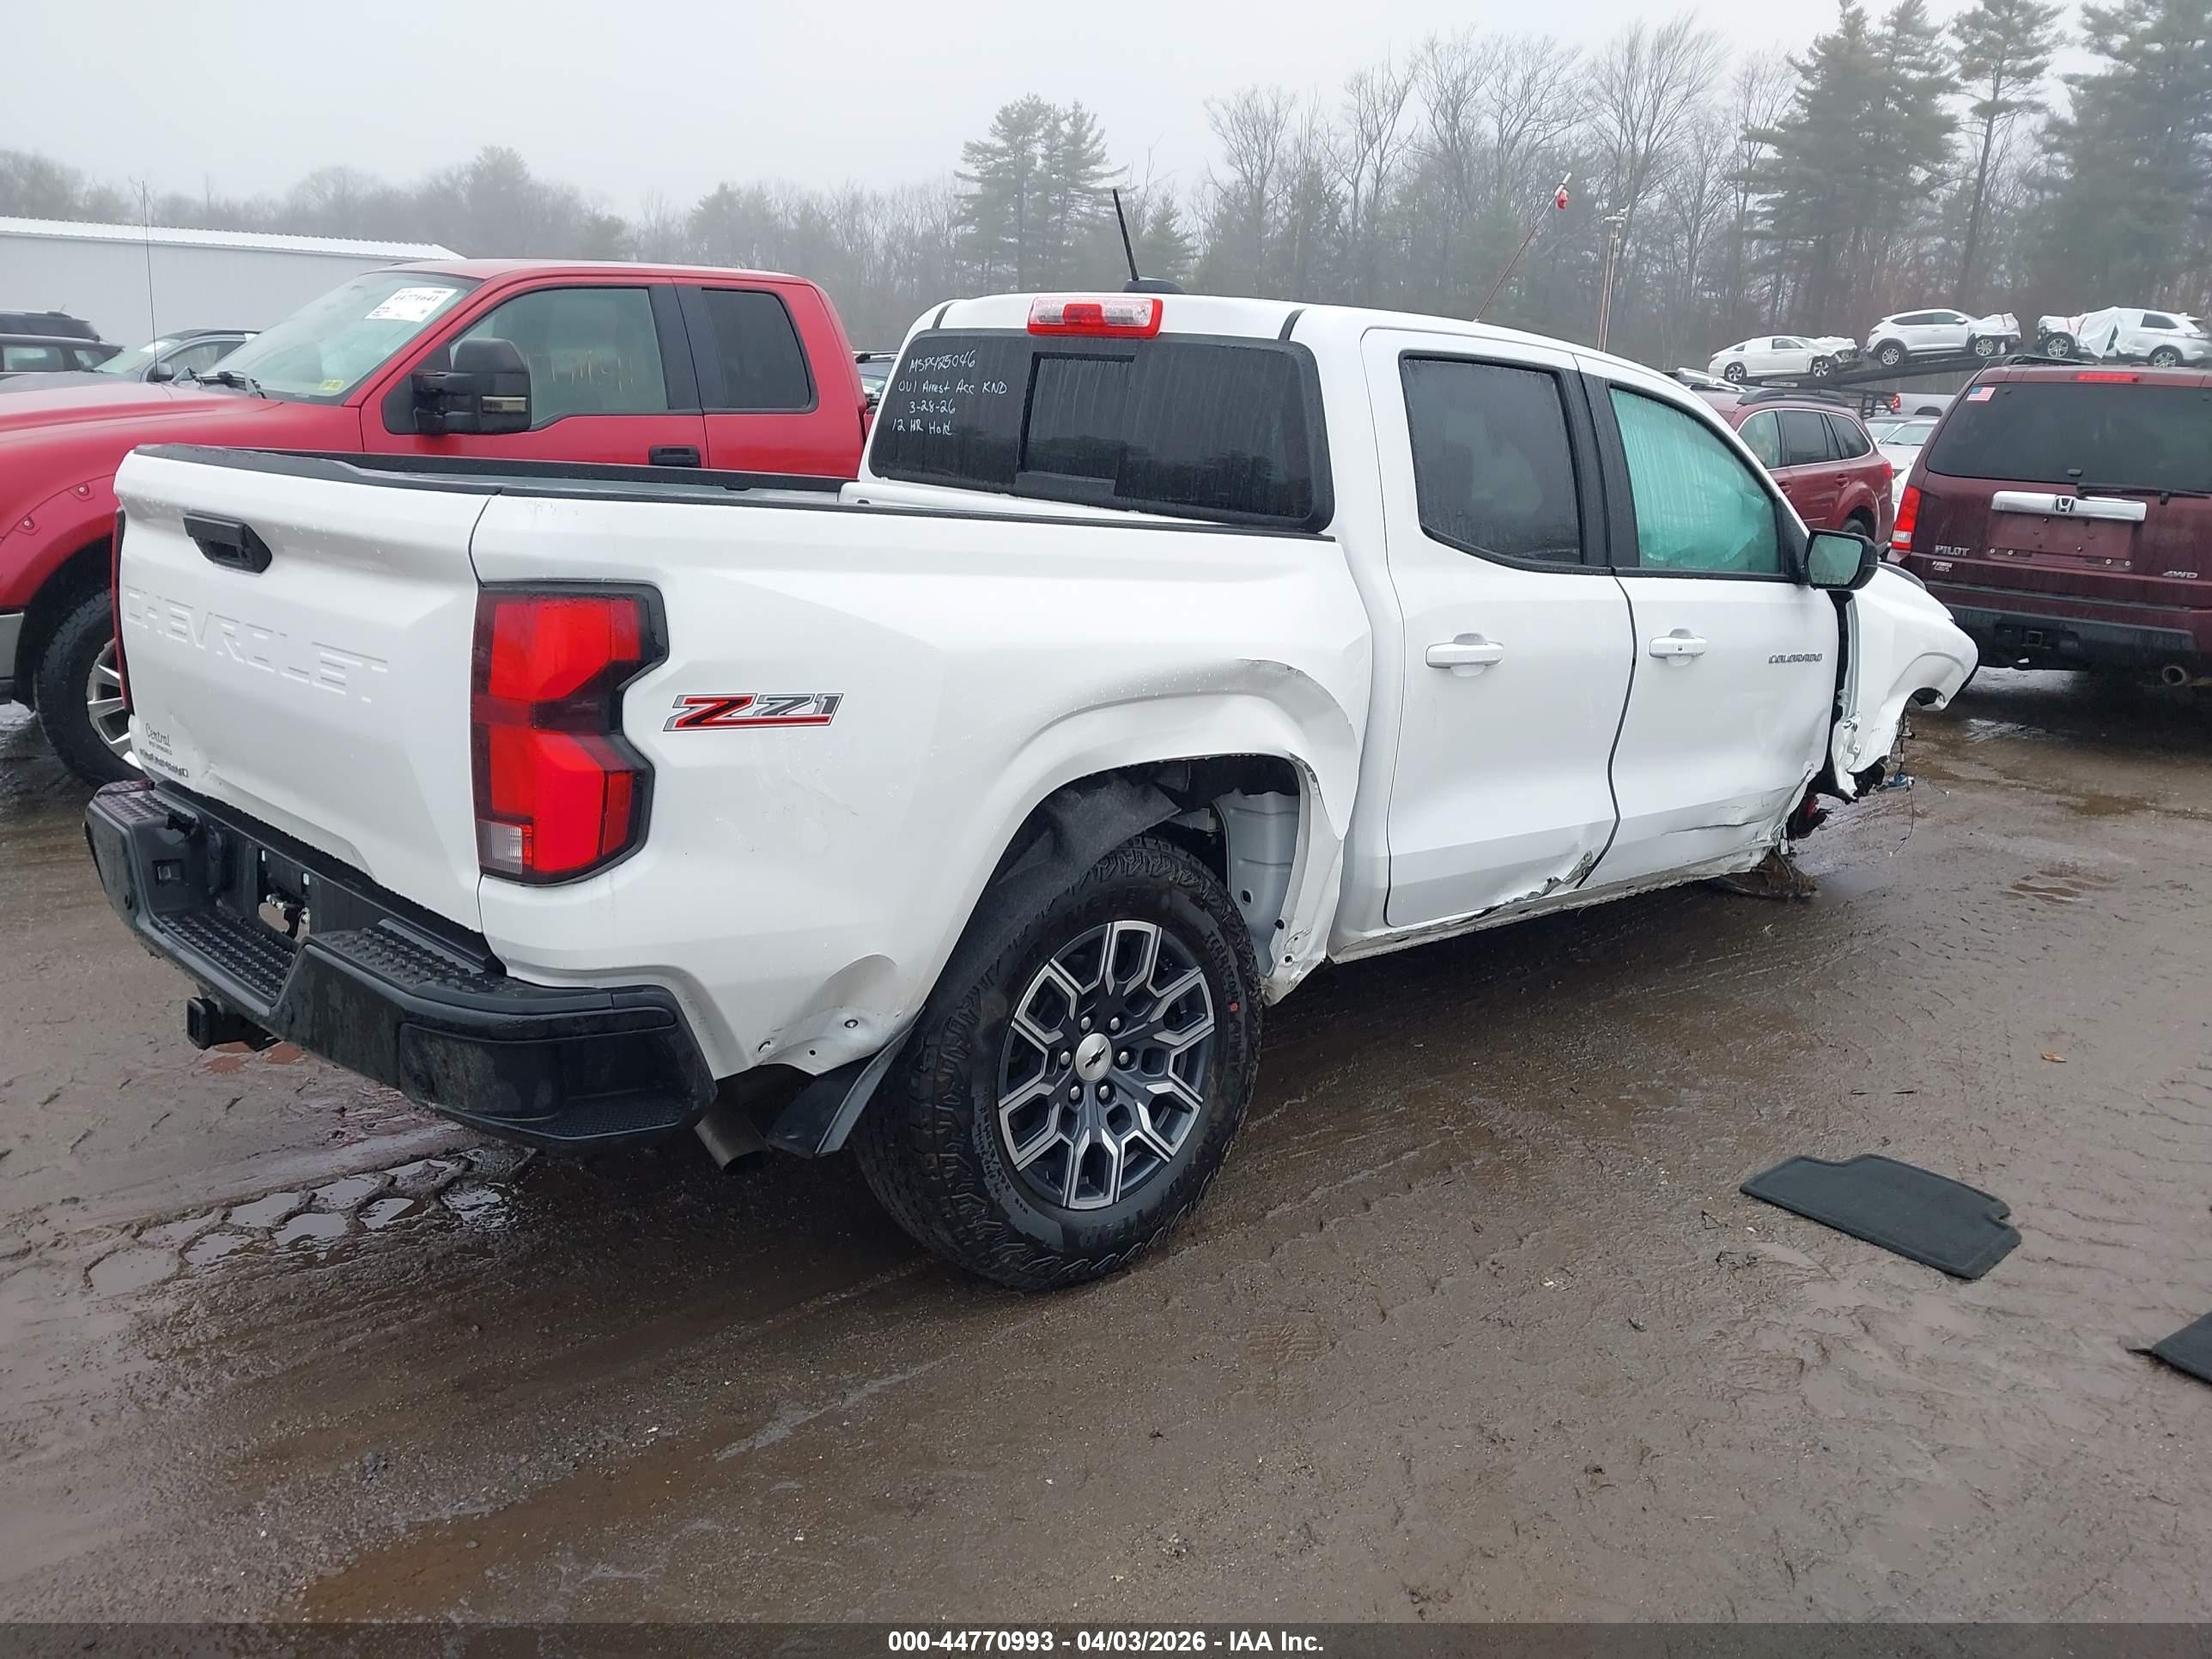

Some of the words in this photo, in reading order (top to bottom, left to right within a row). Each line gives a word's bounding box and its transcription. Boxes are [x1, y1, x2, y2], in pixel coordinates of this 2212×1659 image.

[922, 379, 951, 394] Arrest
[955, 378, 975, 395] Acc
[908, 398, 956, 414] 3-28-26
[891, 418, 906, 432] 12
[909, 418, 924, 433] HR
[1935, 544, 1971, 556] PILOT
[125, 584, 389, 703] CHEVROLET
[1768, 653, 1823, 664] COLORADO
[663, 692, 844, 732] Z71
